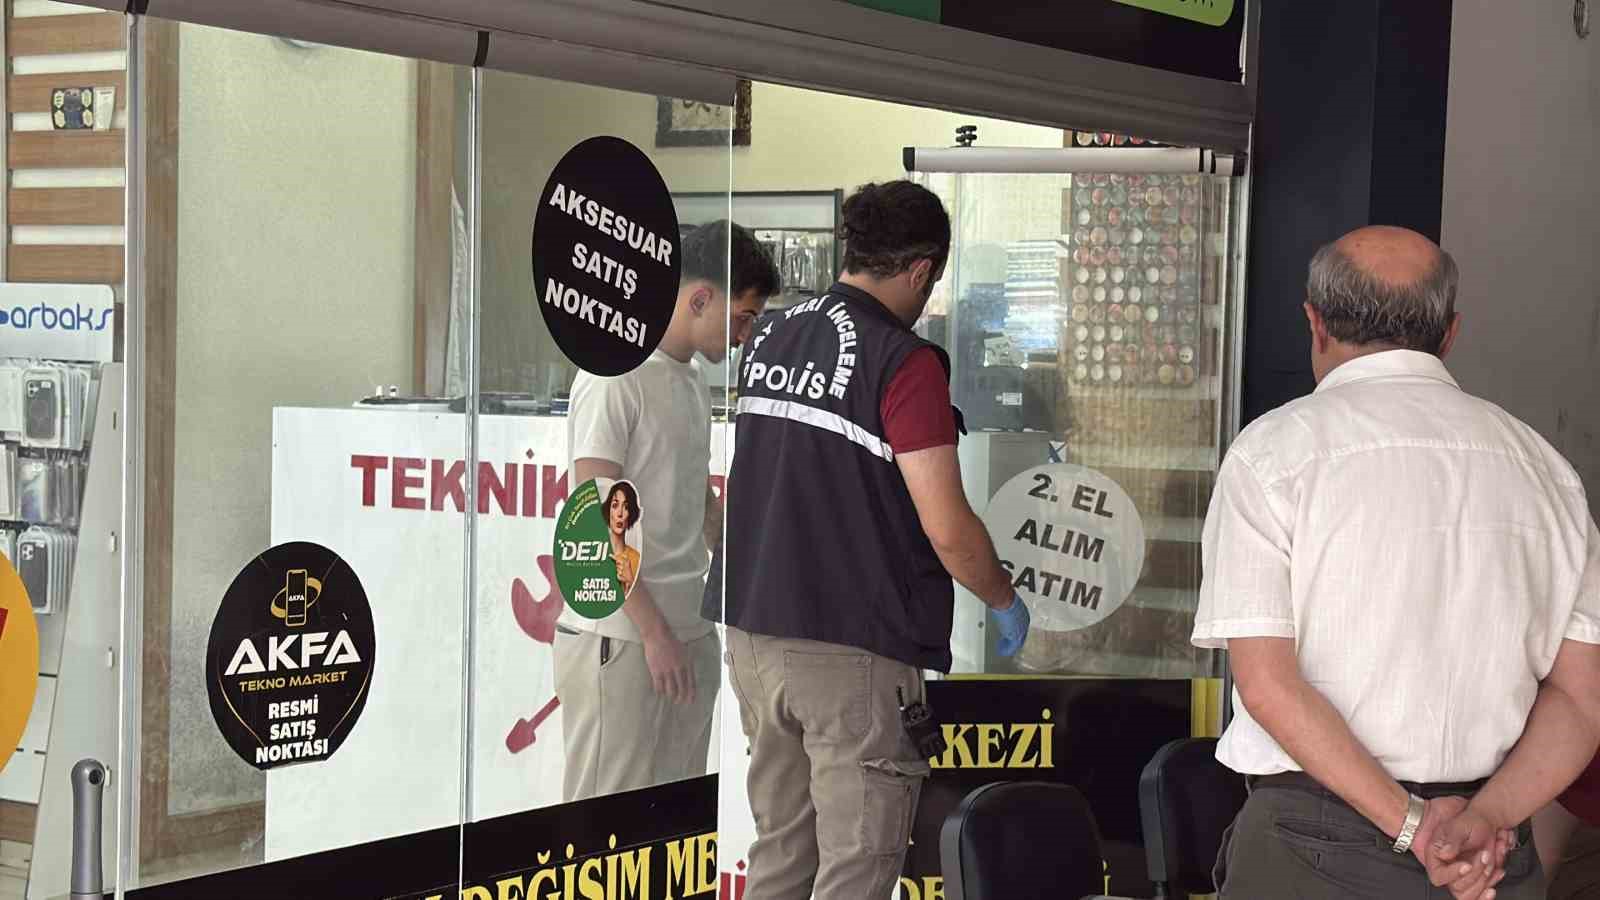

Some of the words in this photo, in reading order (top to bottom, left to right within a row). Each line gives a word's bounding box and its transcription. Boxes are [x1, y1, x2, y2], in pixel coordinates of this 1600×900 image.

[549, 183, 673, 266] AKSESUAR
[571, 243, 638, 300] SATIŞ
[544, 277, 647, 348] NOKTASI
[747, 361, 826, 400] POLİS
[351, 448, 569, 518] TEKNİK
[1028, 473, 1058, 502] 2.
[1071, 484, 1113, 518] EL
[558, 540, 608, 560] DEJI
[1014, 518, 1105, 563] ALIM
[574, 590, 617, 602] NOKTASI
[224, 629, 361, 676] AKFA
[240, 678, 286, 693] TEKNO
[289, 671, 348, 687] MARKET
[268, 694, 319, 719] RESMİ
[256, 738, 329, 763] NOKTASI
[270, 720, 317, 740] SATIŞ
[929, 708, 1055, 768] KEZİ
